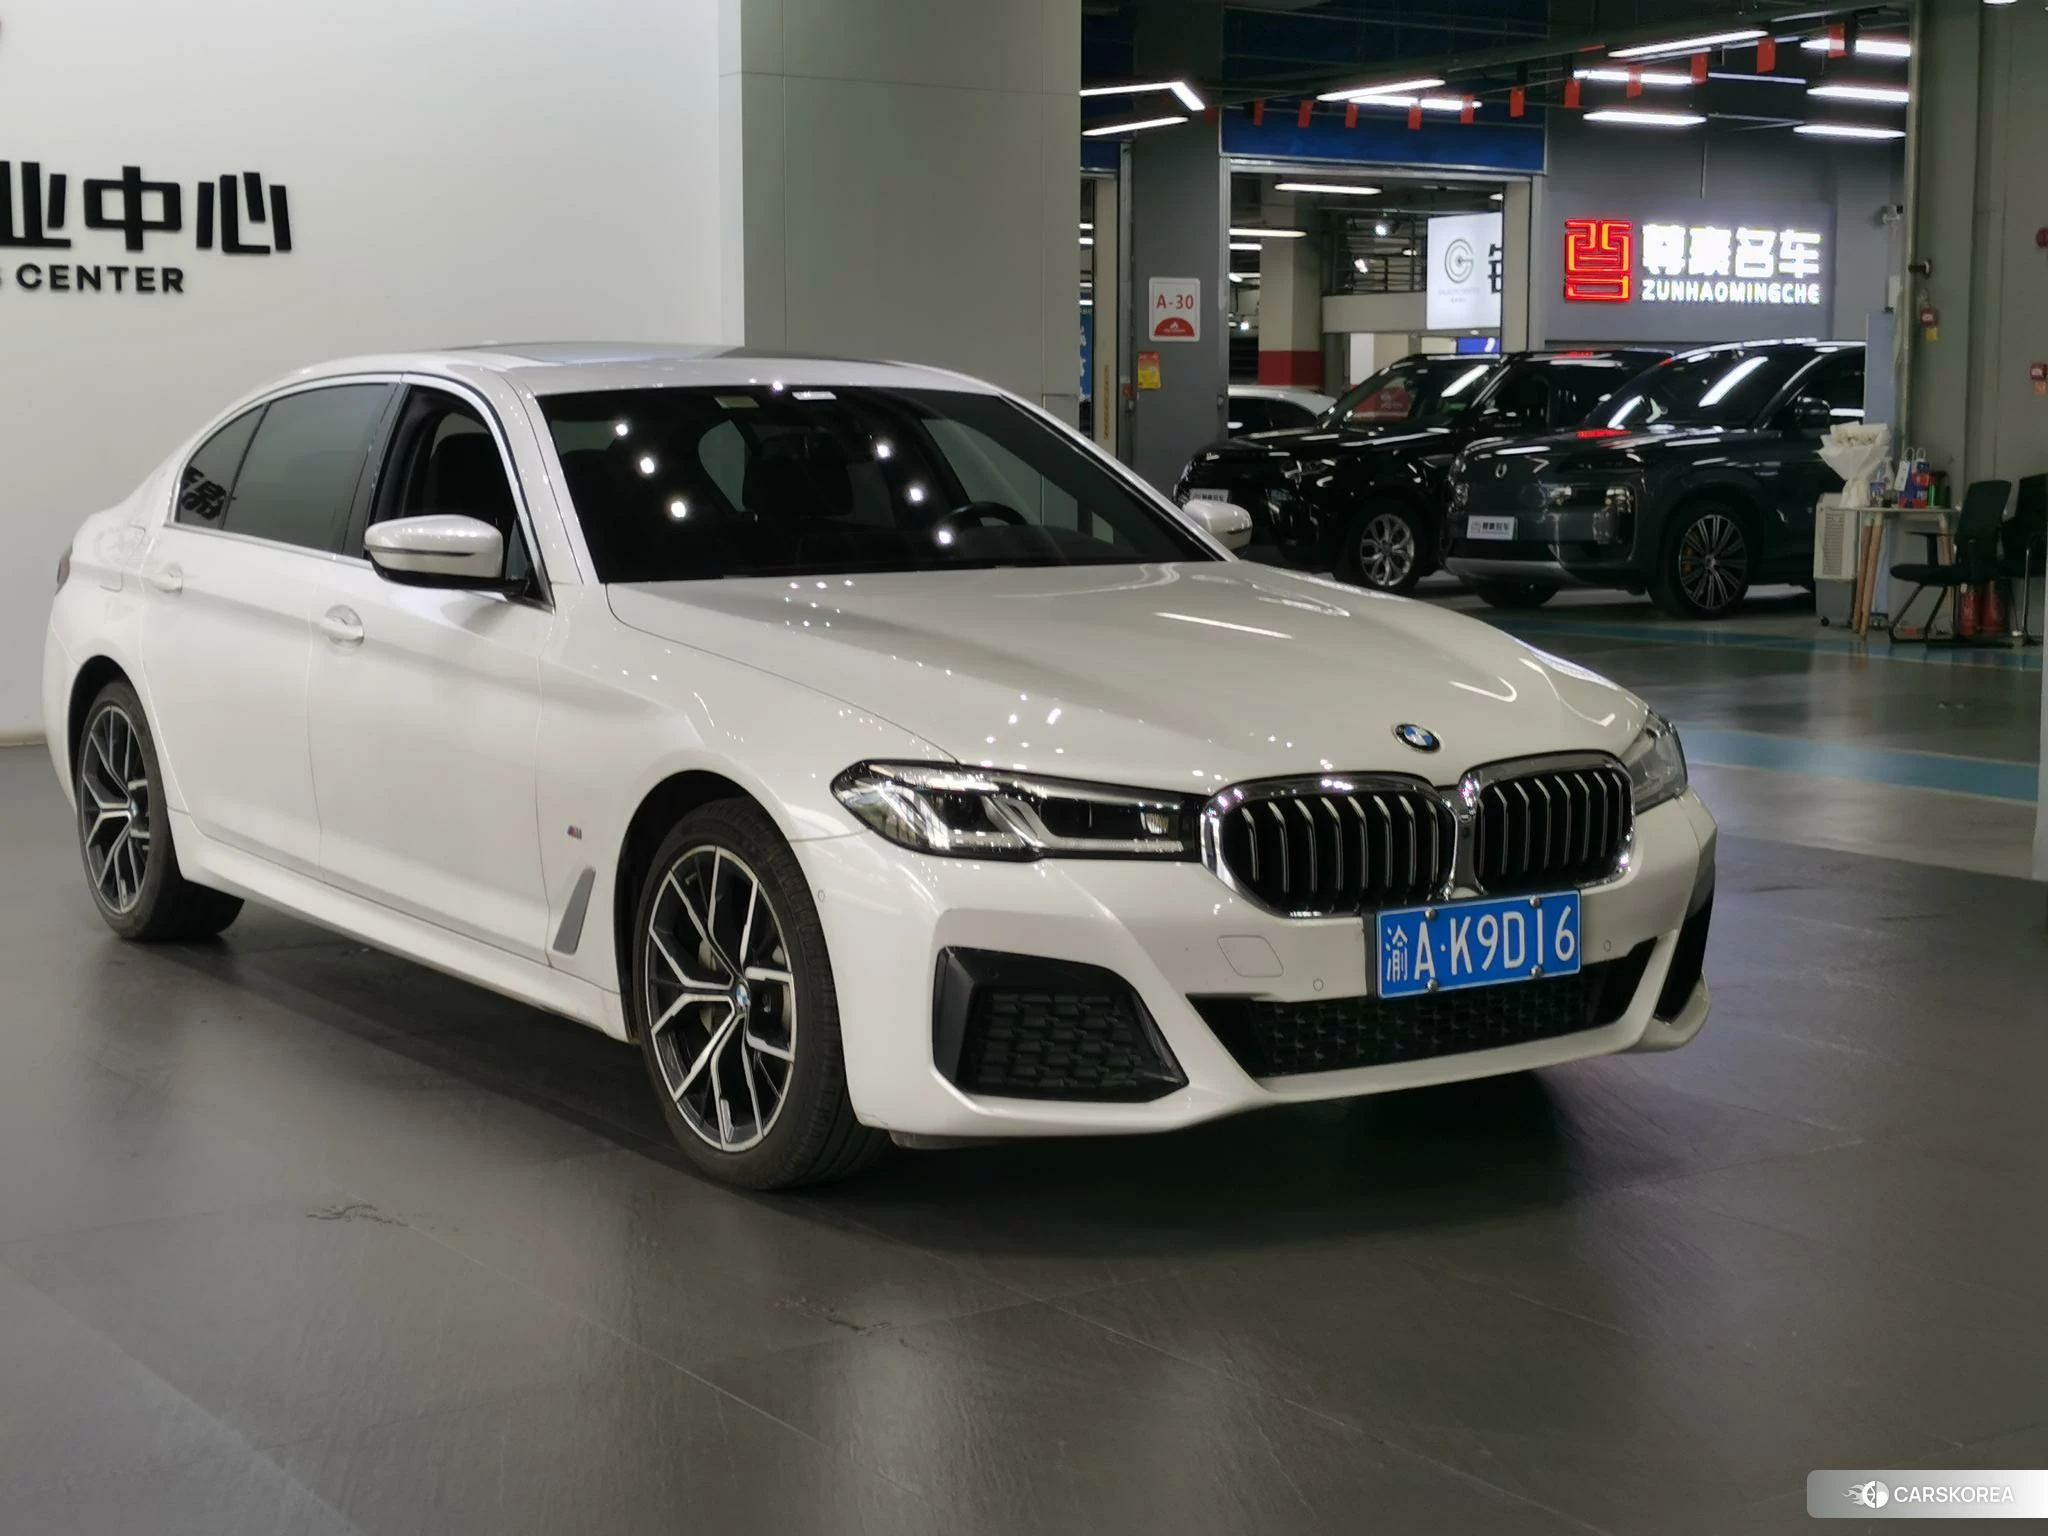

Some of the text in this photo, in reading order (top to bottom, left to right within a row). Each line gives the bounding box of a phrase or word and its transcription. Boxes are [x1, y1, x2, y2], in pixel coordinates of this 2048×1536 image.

[16, 263, 184, 293] CENTER
[1156, 294, 1194, 309] A-30
[1641, 279, 1821, 304] ZUNHAOMINGCHE
